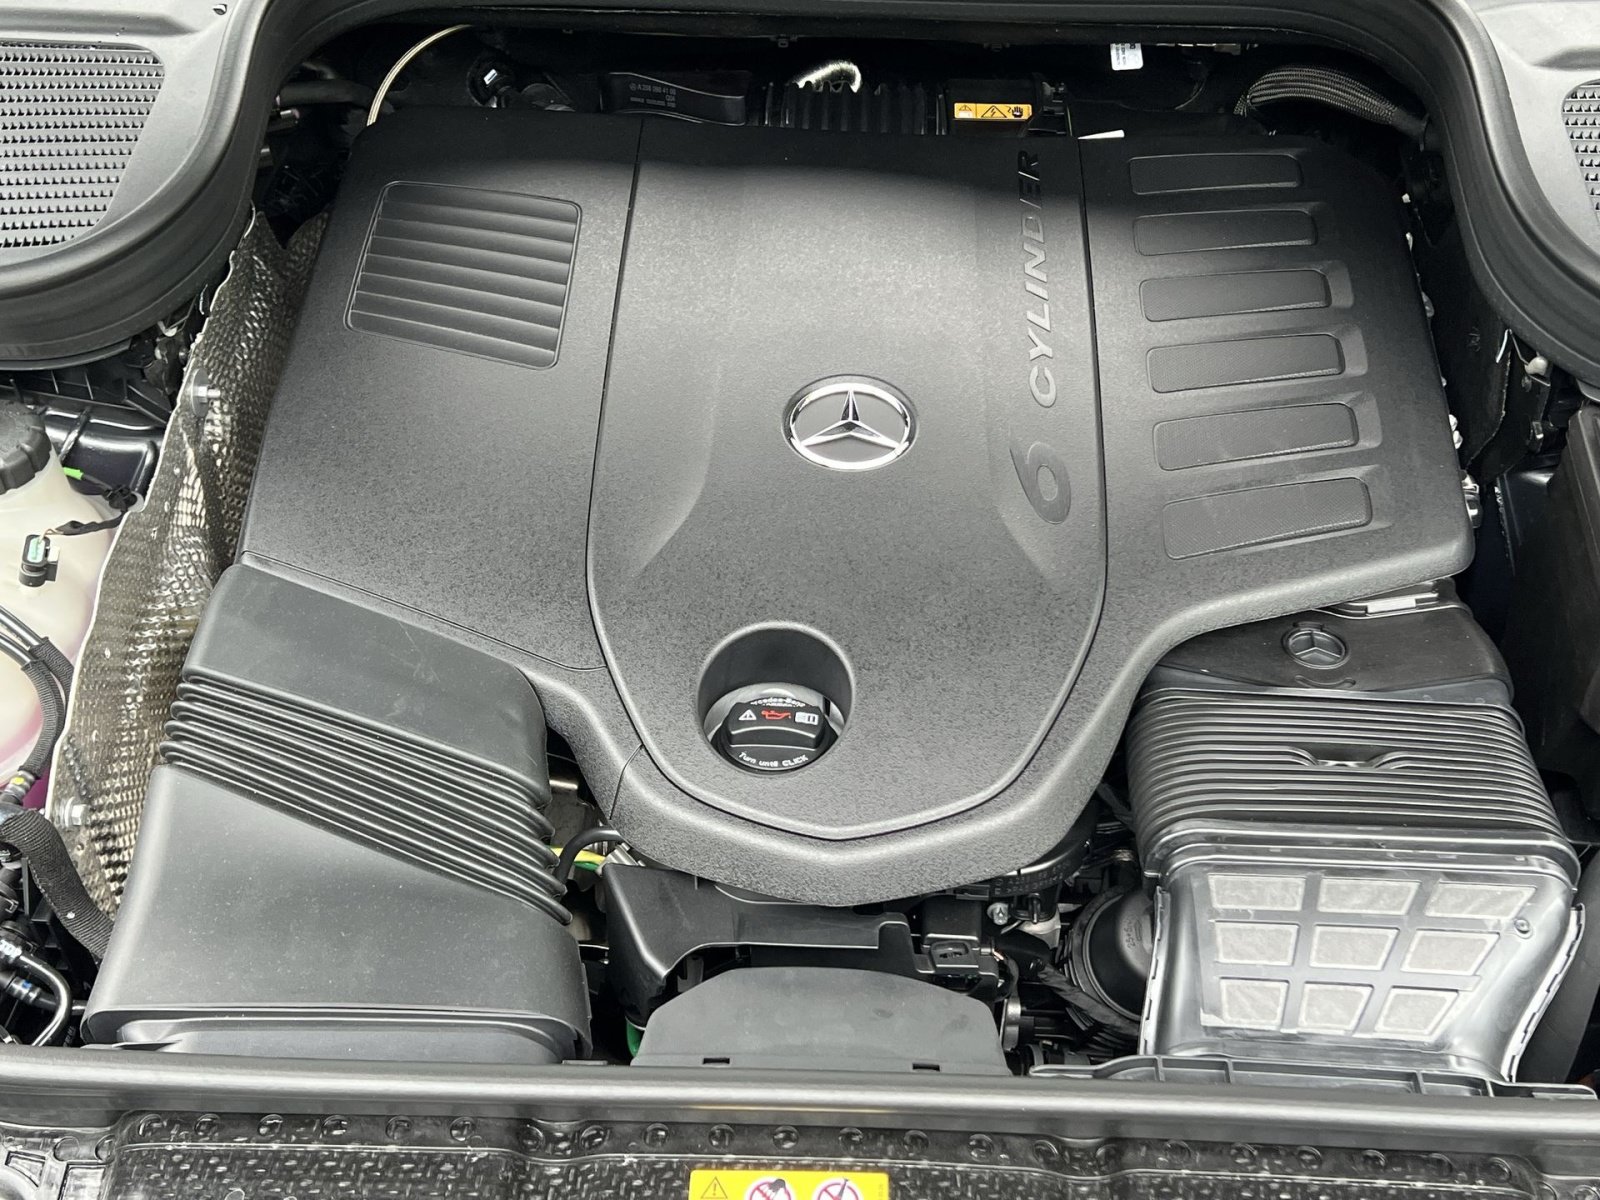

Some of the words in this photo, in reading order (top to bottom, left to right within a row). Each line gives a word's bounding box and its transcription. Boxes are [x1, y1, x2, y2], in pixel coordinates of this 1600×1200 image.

[1018, 149, 1058, 409] CYLINDER
[1009, 436, 1072, 525] 6
[739, 752, 757, 764] Turn
[782, 754, 809, 767] CLICK
